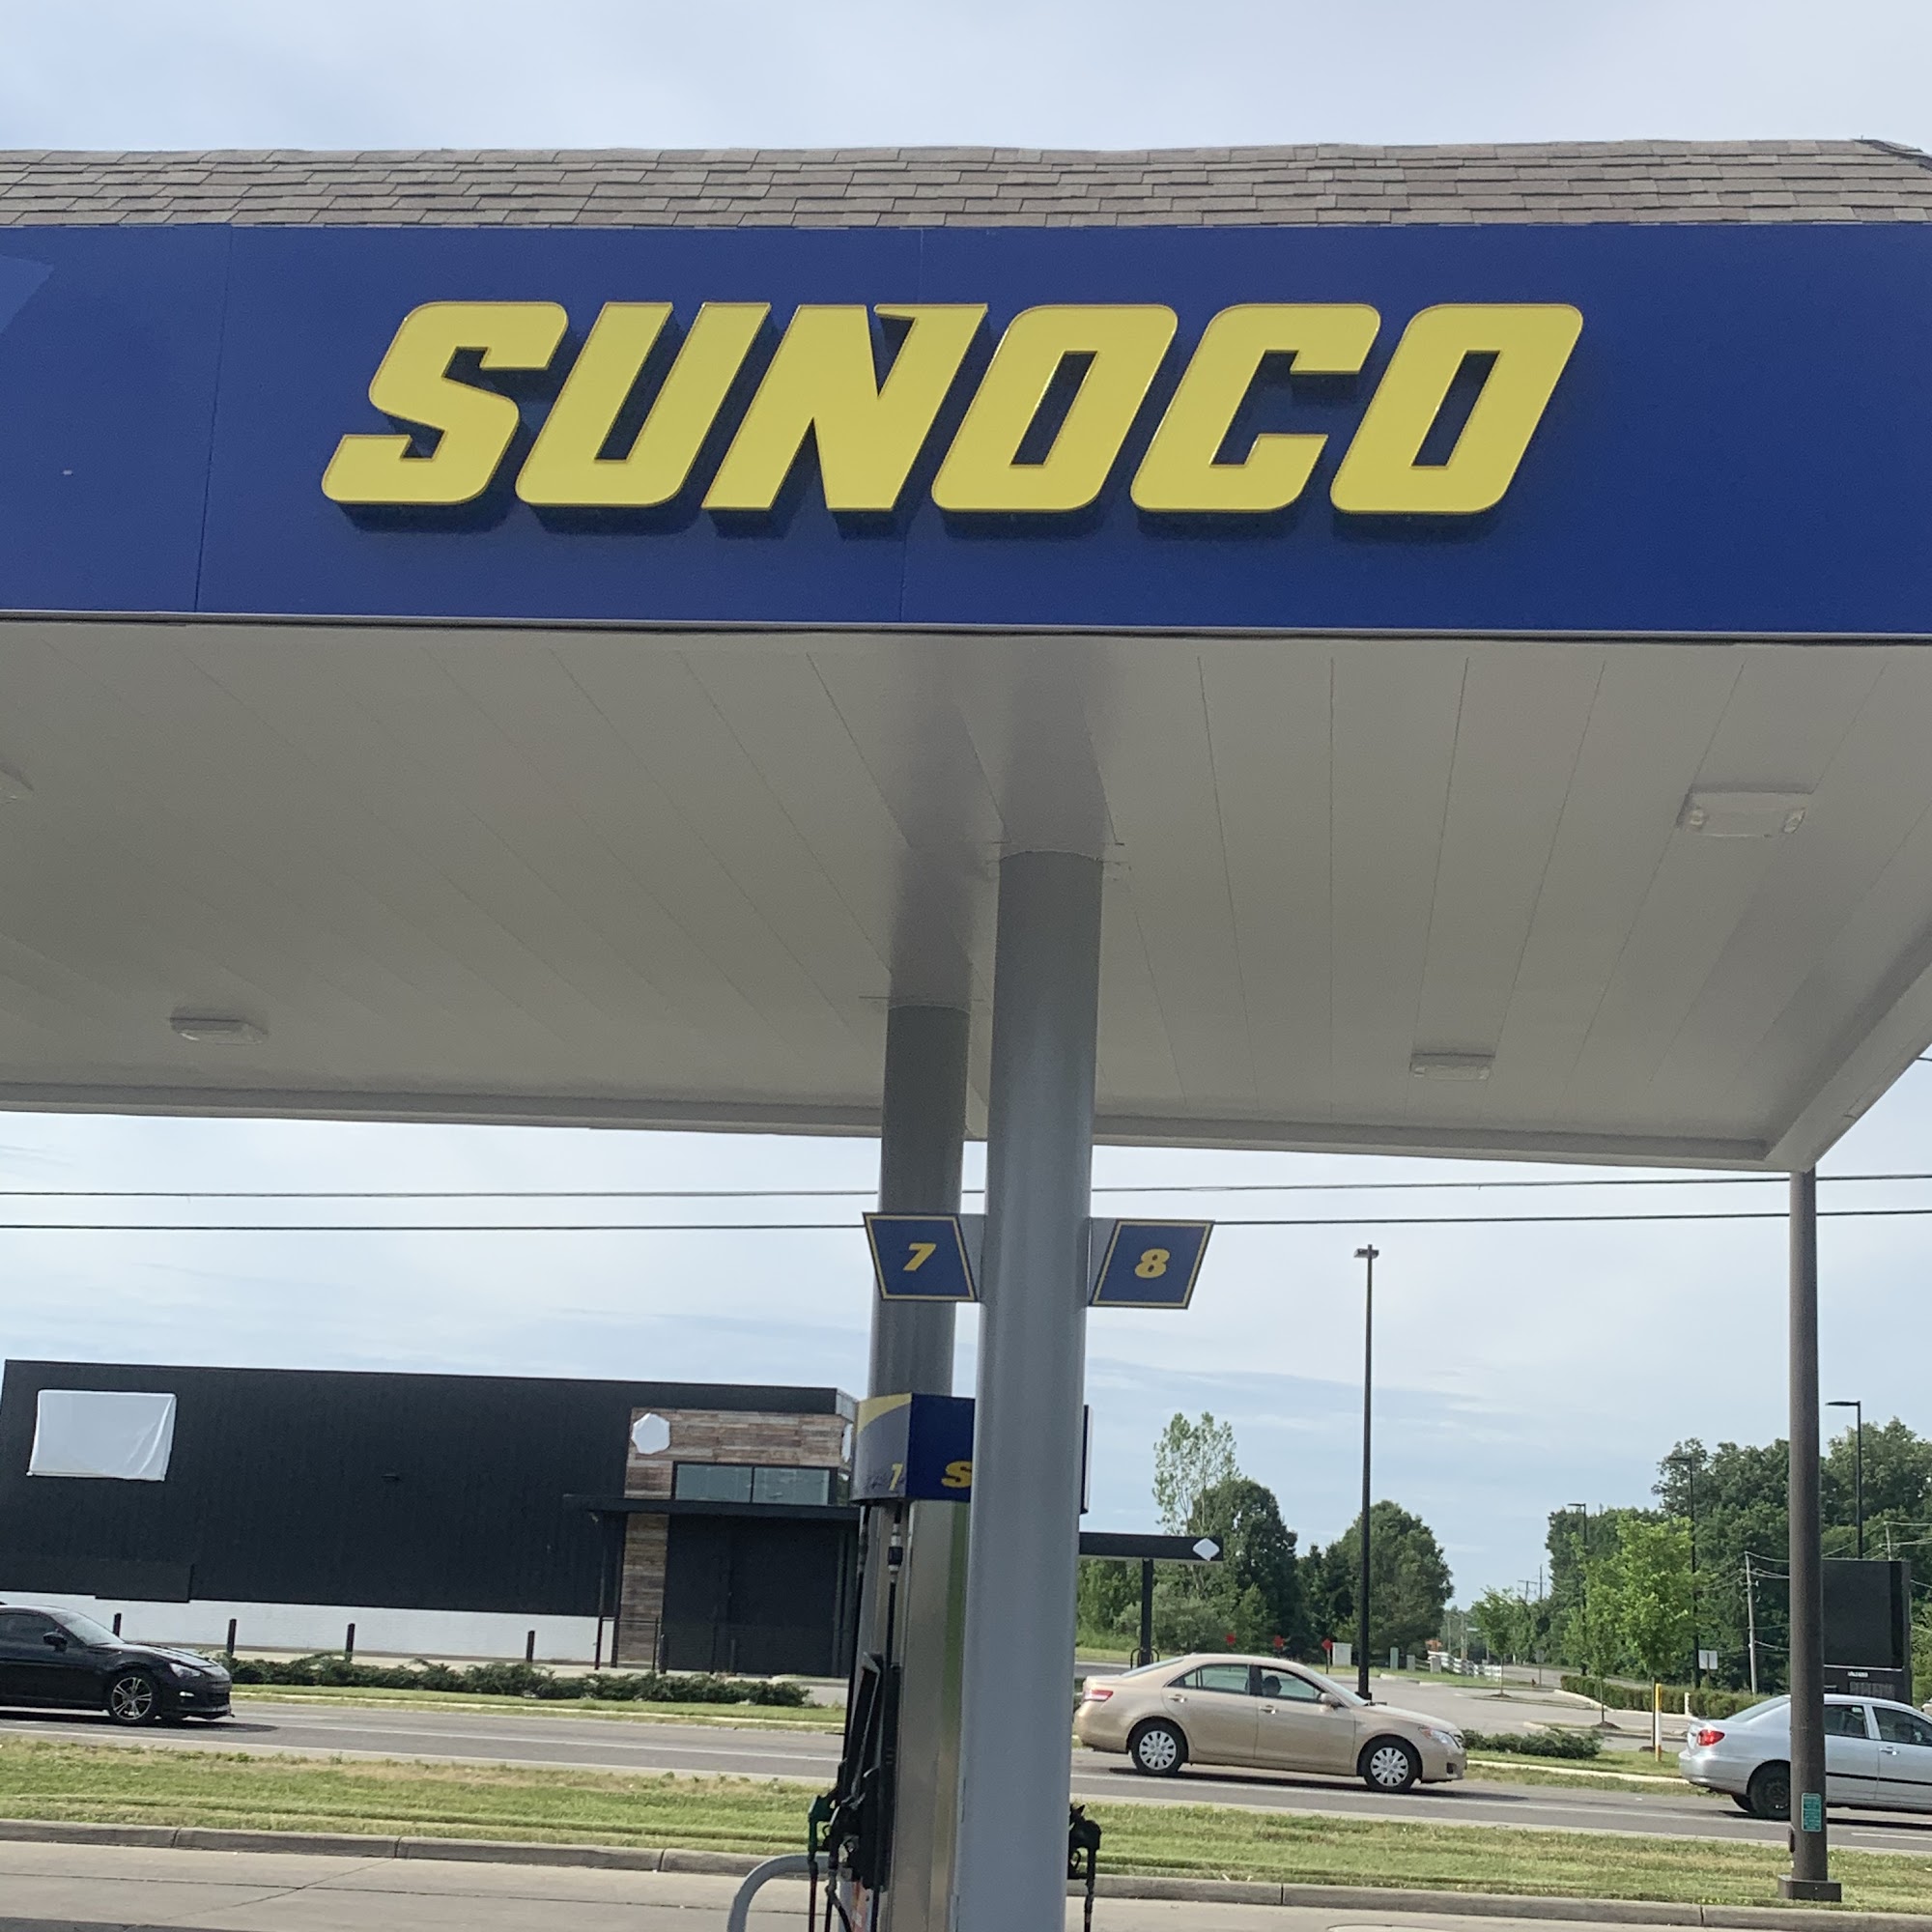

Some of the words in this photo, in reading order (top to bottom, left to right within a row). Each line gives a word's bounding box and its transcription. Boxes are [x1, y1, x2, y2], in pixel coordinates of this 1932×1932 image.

[322, 301, 1583, 514] SUNOCO
[903, 1242, 936, 1271] 7
[1135, 1248, 1169, 1278] 8
